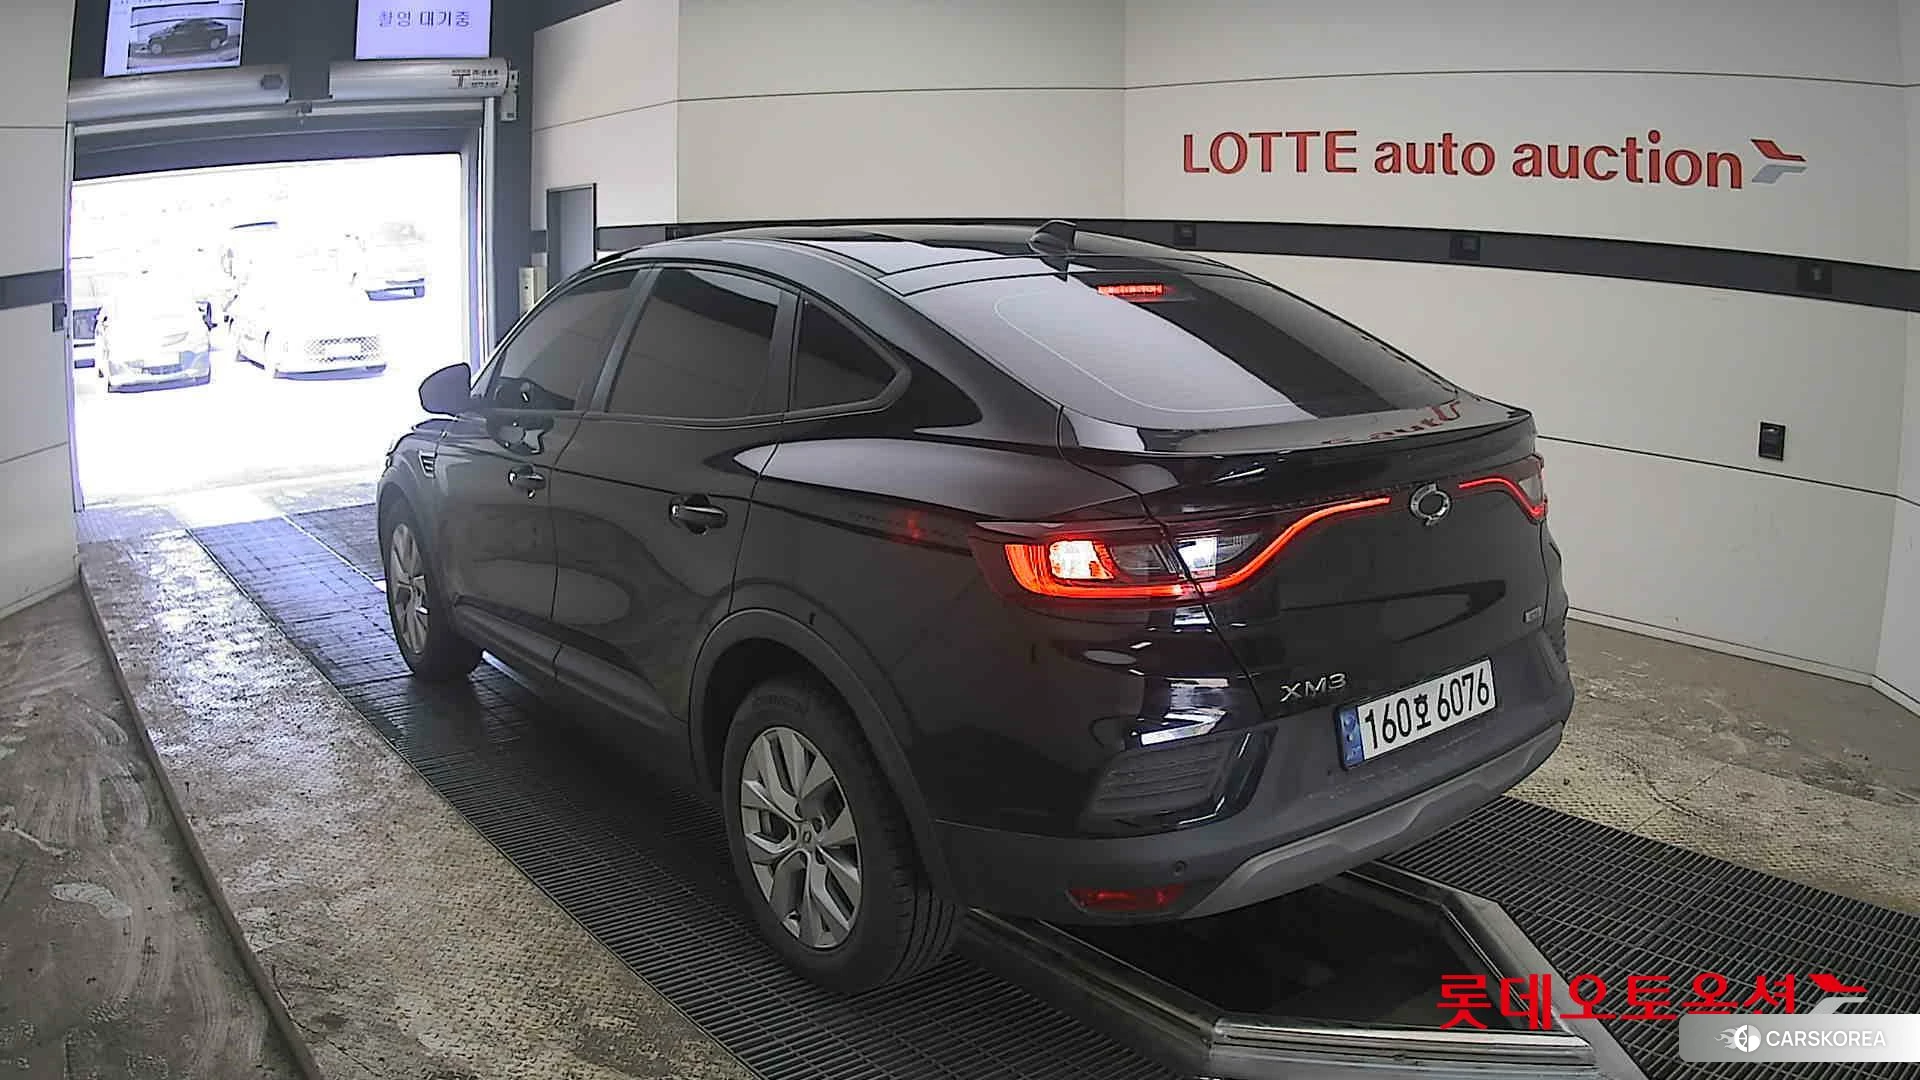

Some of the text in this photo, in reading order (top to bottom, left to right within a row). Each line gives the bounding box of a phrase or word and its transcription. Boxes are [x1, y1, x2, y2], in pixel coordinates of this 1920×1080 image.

[420, 10, 470, 28] 대기중
[1183, 129, 1743, 189] LOTTE auto auction
[1279, 672, 1347, 702] XM3
[1365, 668, 1490, 750] 160호 6076
